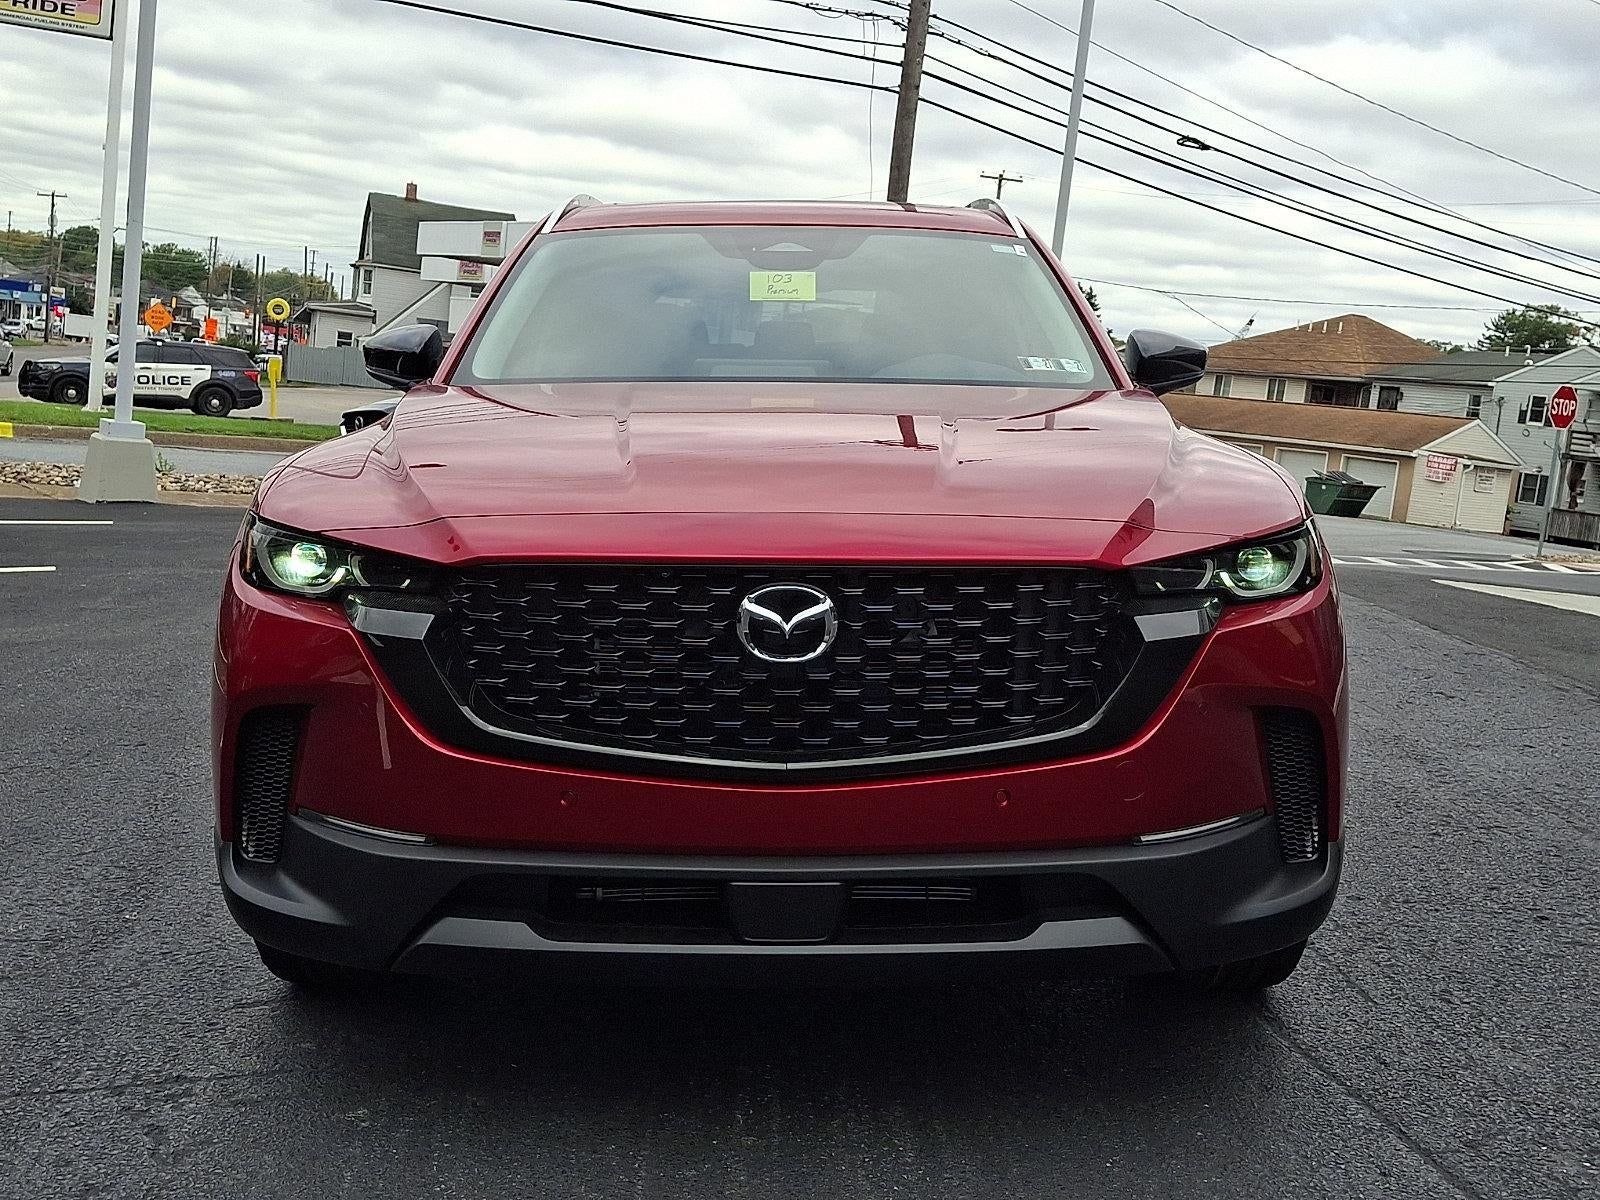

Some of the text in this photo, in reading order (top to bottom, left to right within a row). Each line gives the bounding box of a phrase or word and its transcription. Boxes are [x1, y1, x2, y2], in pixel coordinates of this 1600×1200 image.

[0, 0, 76, 17] RIDE
[767, 273, 793, 284] 103
[133, 374, 191, 386] OLICE
[1551, 398, 1576, 416] STOP
[1427, 461, 1439, 469] FOR
[1428, 455, 1457, 465] GARAGE
